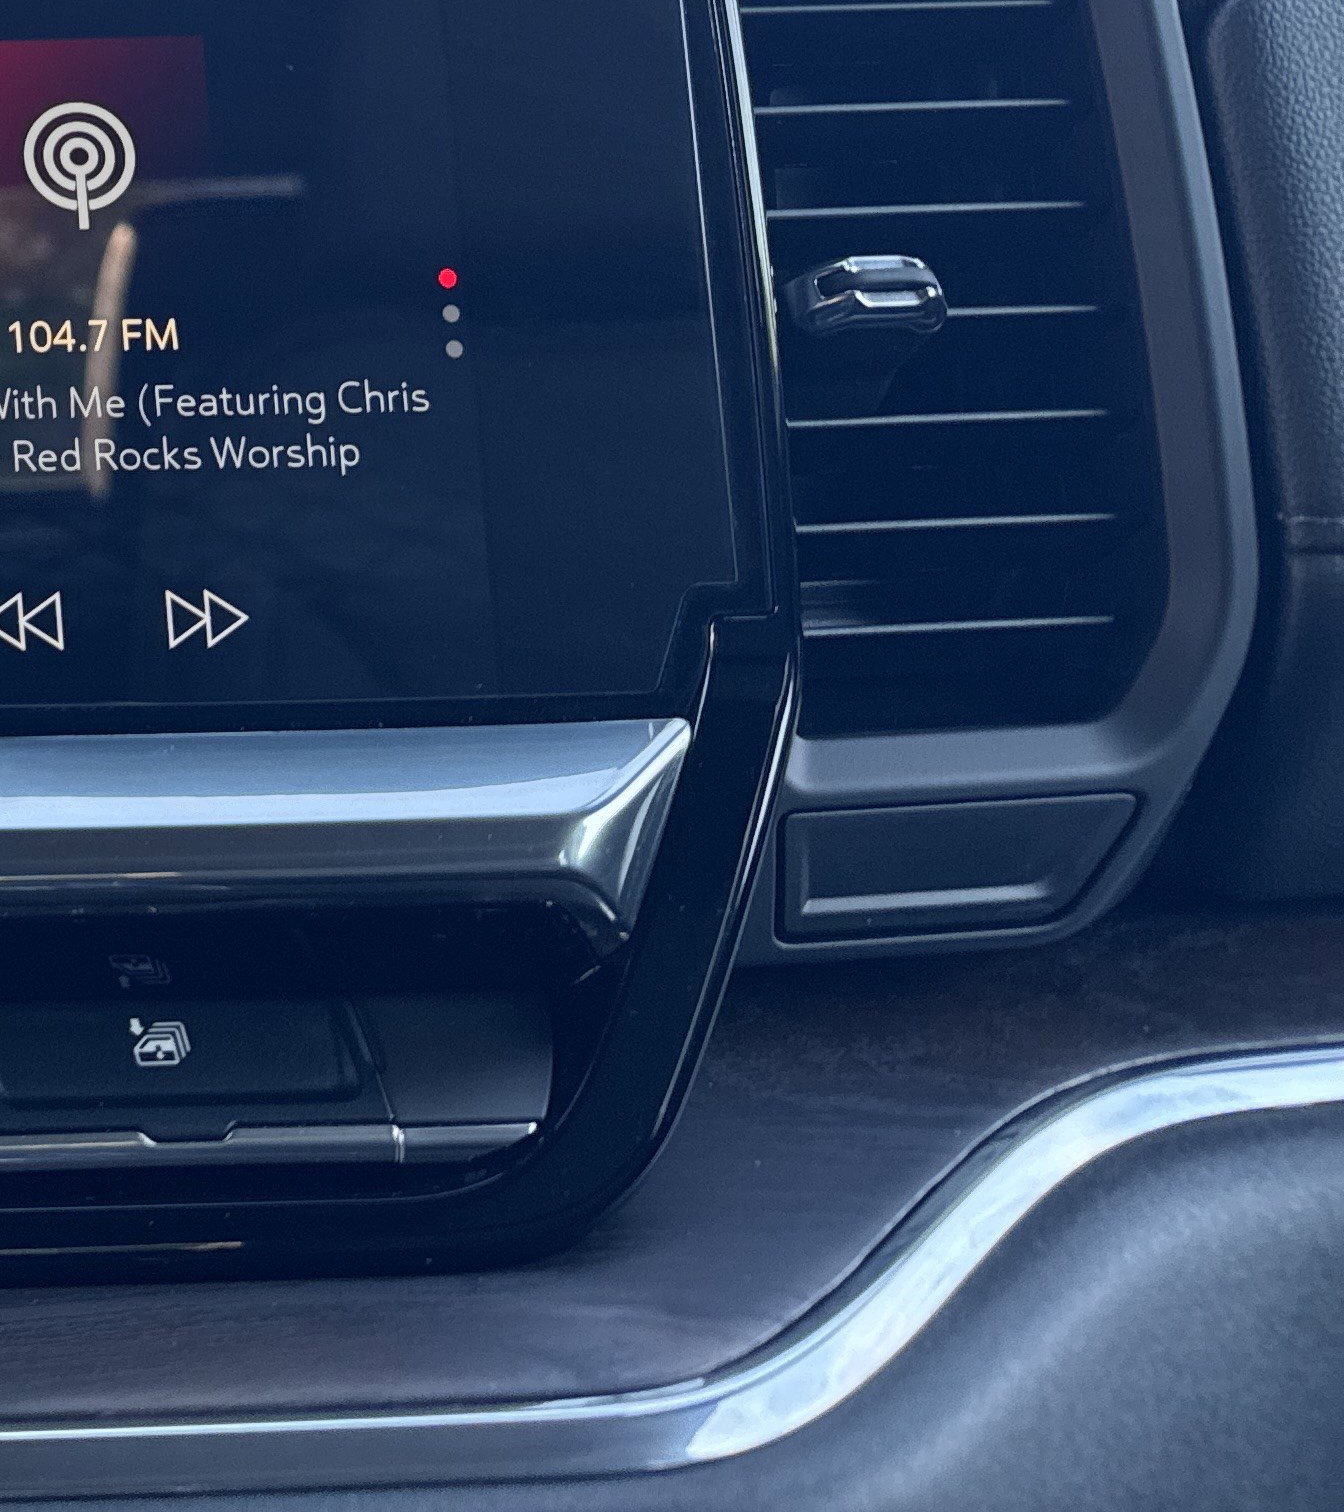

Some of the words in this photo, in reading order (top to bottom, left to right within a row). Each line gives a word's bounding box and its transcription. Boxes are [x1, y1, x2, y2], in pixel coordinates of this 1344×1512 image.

[8, 318, 108, 354] 104.7
[122, 317, 180, 352] FM
[70, 386, 126, 420] Me
[138, 381, 326, 426] (Featuring
[338, 379, 431, 414] Chris
[13, 437, 81, 473] Red
[95, 436, 202, 472] Rocks
[210, 433, 361, 476] Worship
